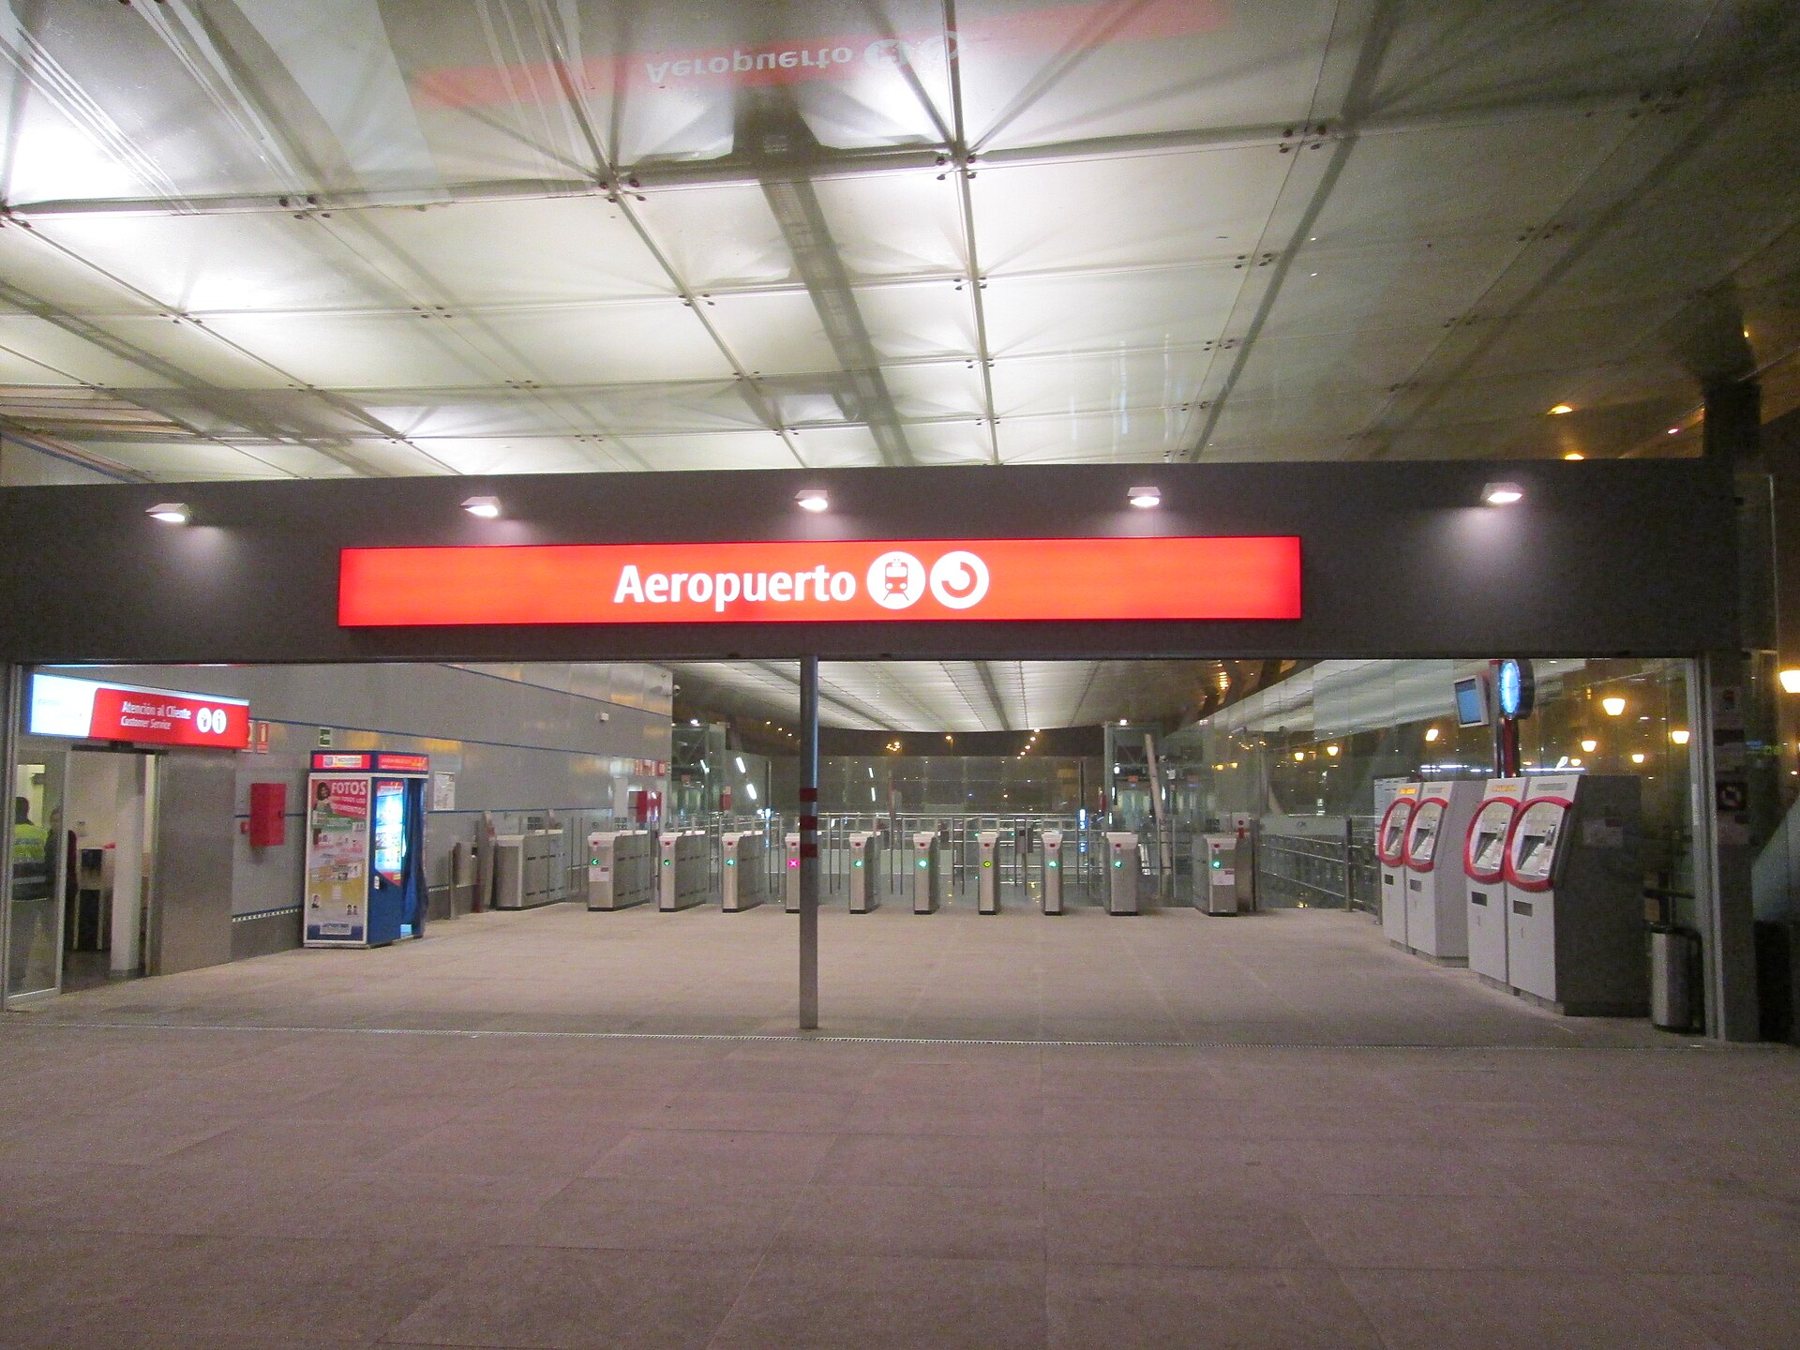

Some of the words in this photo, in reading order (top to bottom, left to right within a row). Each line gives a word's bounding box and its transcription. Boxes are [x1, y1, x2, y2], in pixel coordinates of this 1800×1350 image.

[614, 565, 856, 612] Aeropuerto
[122, 701, 155, 716] Atención
[157, 704, 165, 717] al
[166, 706, 191, 719] Cliente
[121, 716, 149, 727] Customer
[150, 719, 171, 729] Service
[331, 781, 367, 796] FOTOS
